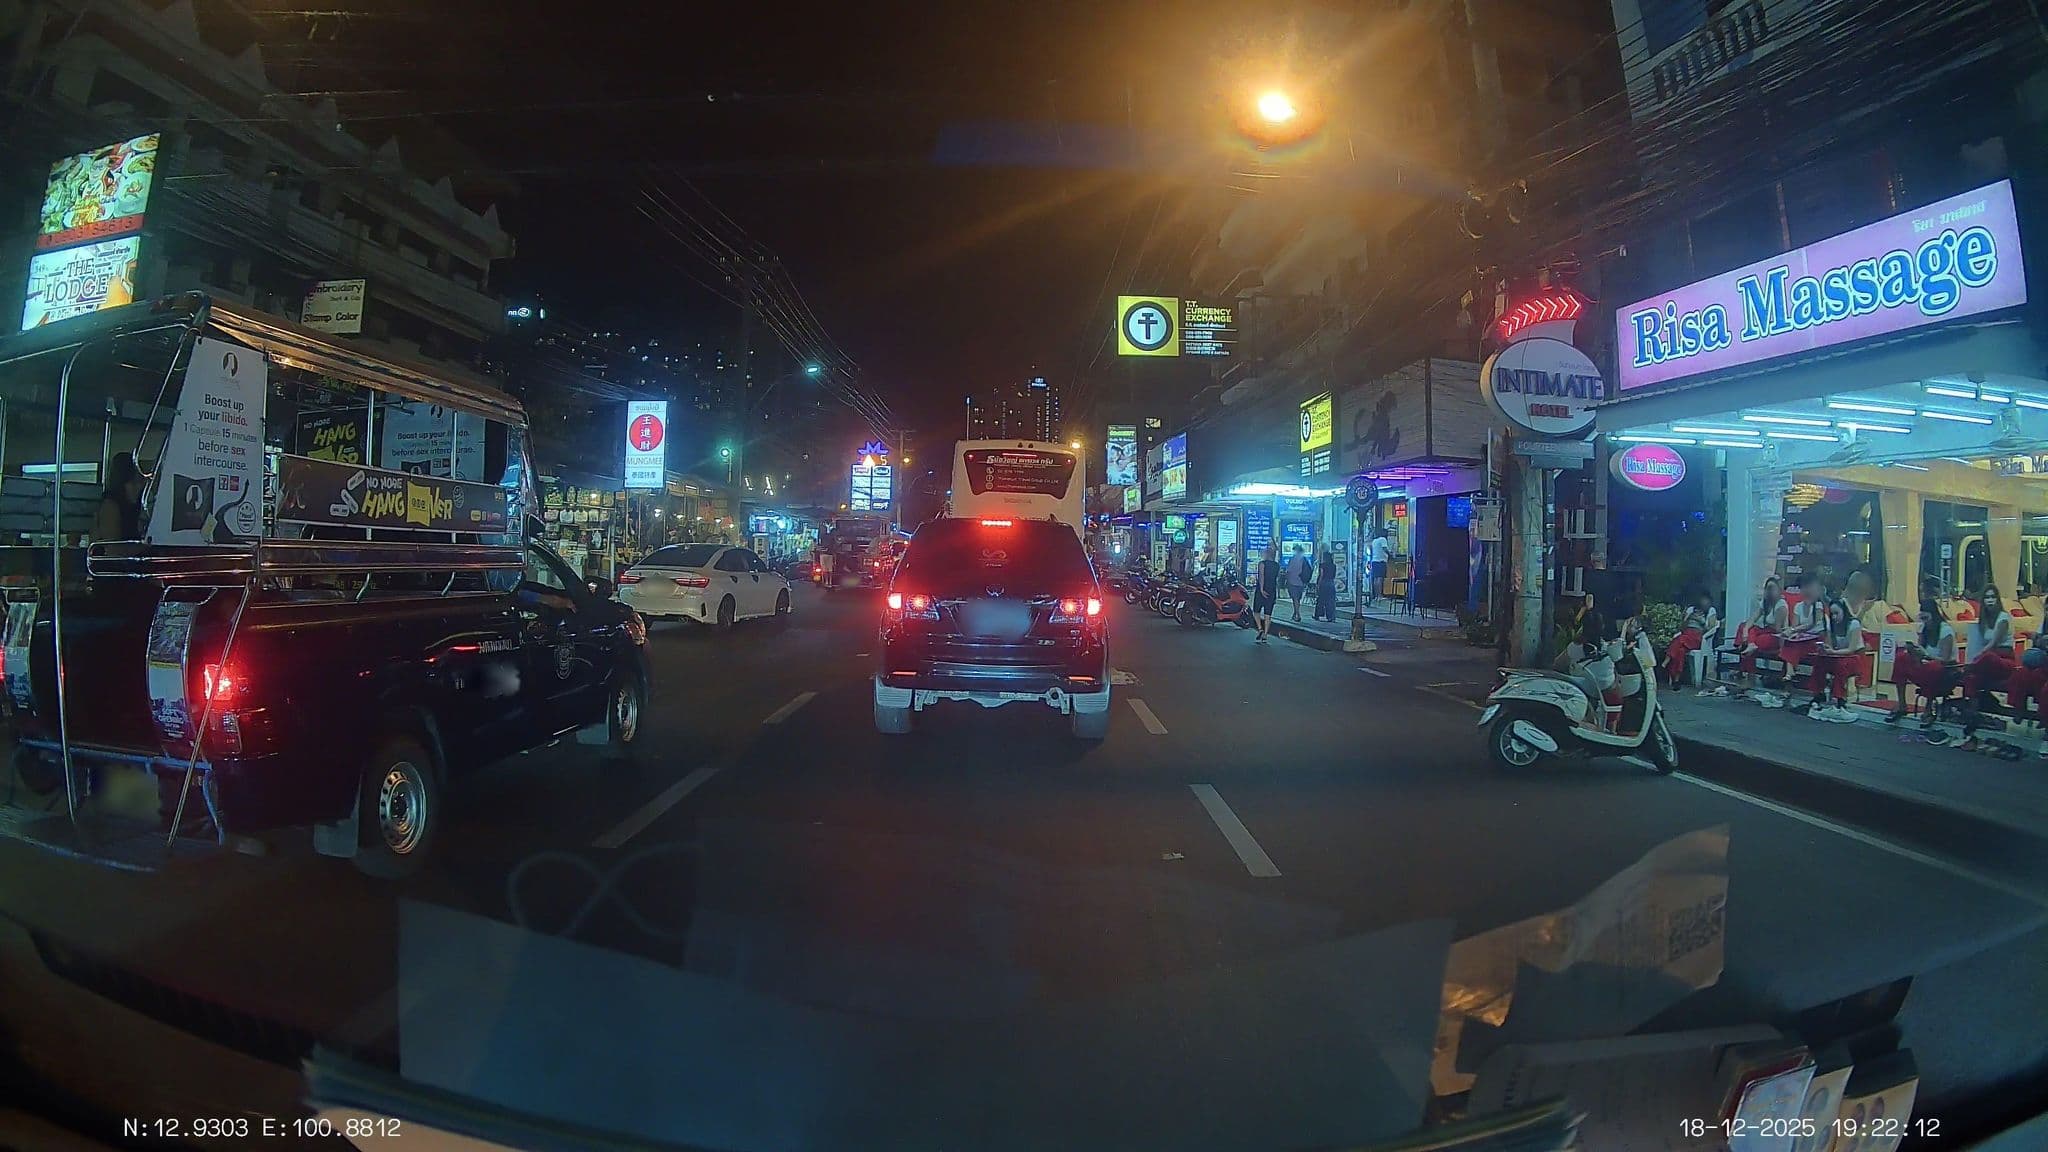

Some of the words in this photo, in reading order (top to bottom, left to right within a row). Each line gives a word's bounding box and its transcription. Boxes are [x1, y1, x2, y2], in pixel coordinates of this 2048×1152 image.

[67, 258, 94, 277] THE
[45, 274, 109, 303] LODGE
[1631, 302, 1731, 367] Risa
[1737, 226, 1997, 341] Massage
[336, 312, 360, 320] Color
[1185, 307, 1231, 315] CURRENCY
[1185, 314, 1232, 322] EXCHANGE
[1497, 367, 1603, 400] INTIMATE
[204, 393, 232, 408] Boost
[233, 402, 244, 413] up
[198, 410, 220, 421] your
[221, 413, 248, 427] libido.
[222, 428, 231, 438] 15
[313, 421, 356, 446] HANG
[397, 432, 418, 440] Boost
[198, 438, 229, 454] before
[231, 446, 246, 456] sex
[193, 453, 248, 472] intercourse.
[626, 457, 663, 465] MUNGMEE
[1625, 456, 1646, 473] Risa
[1646, 458, 1682, 480] Massage
[366, 477, 379, 489] NO
[380, 477, 403, 490] MORE
[361, 489, 406, 519] HANG
